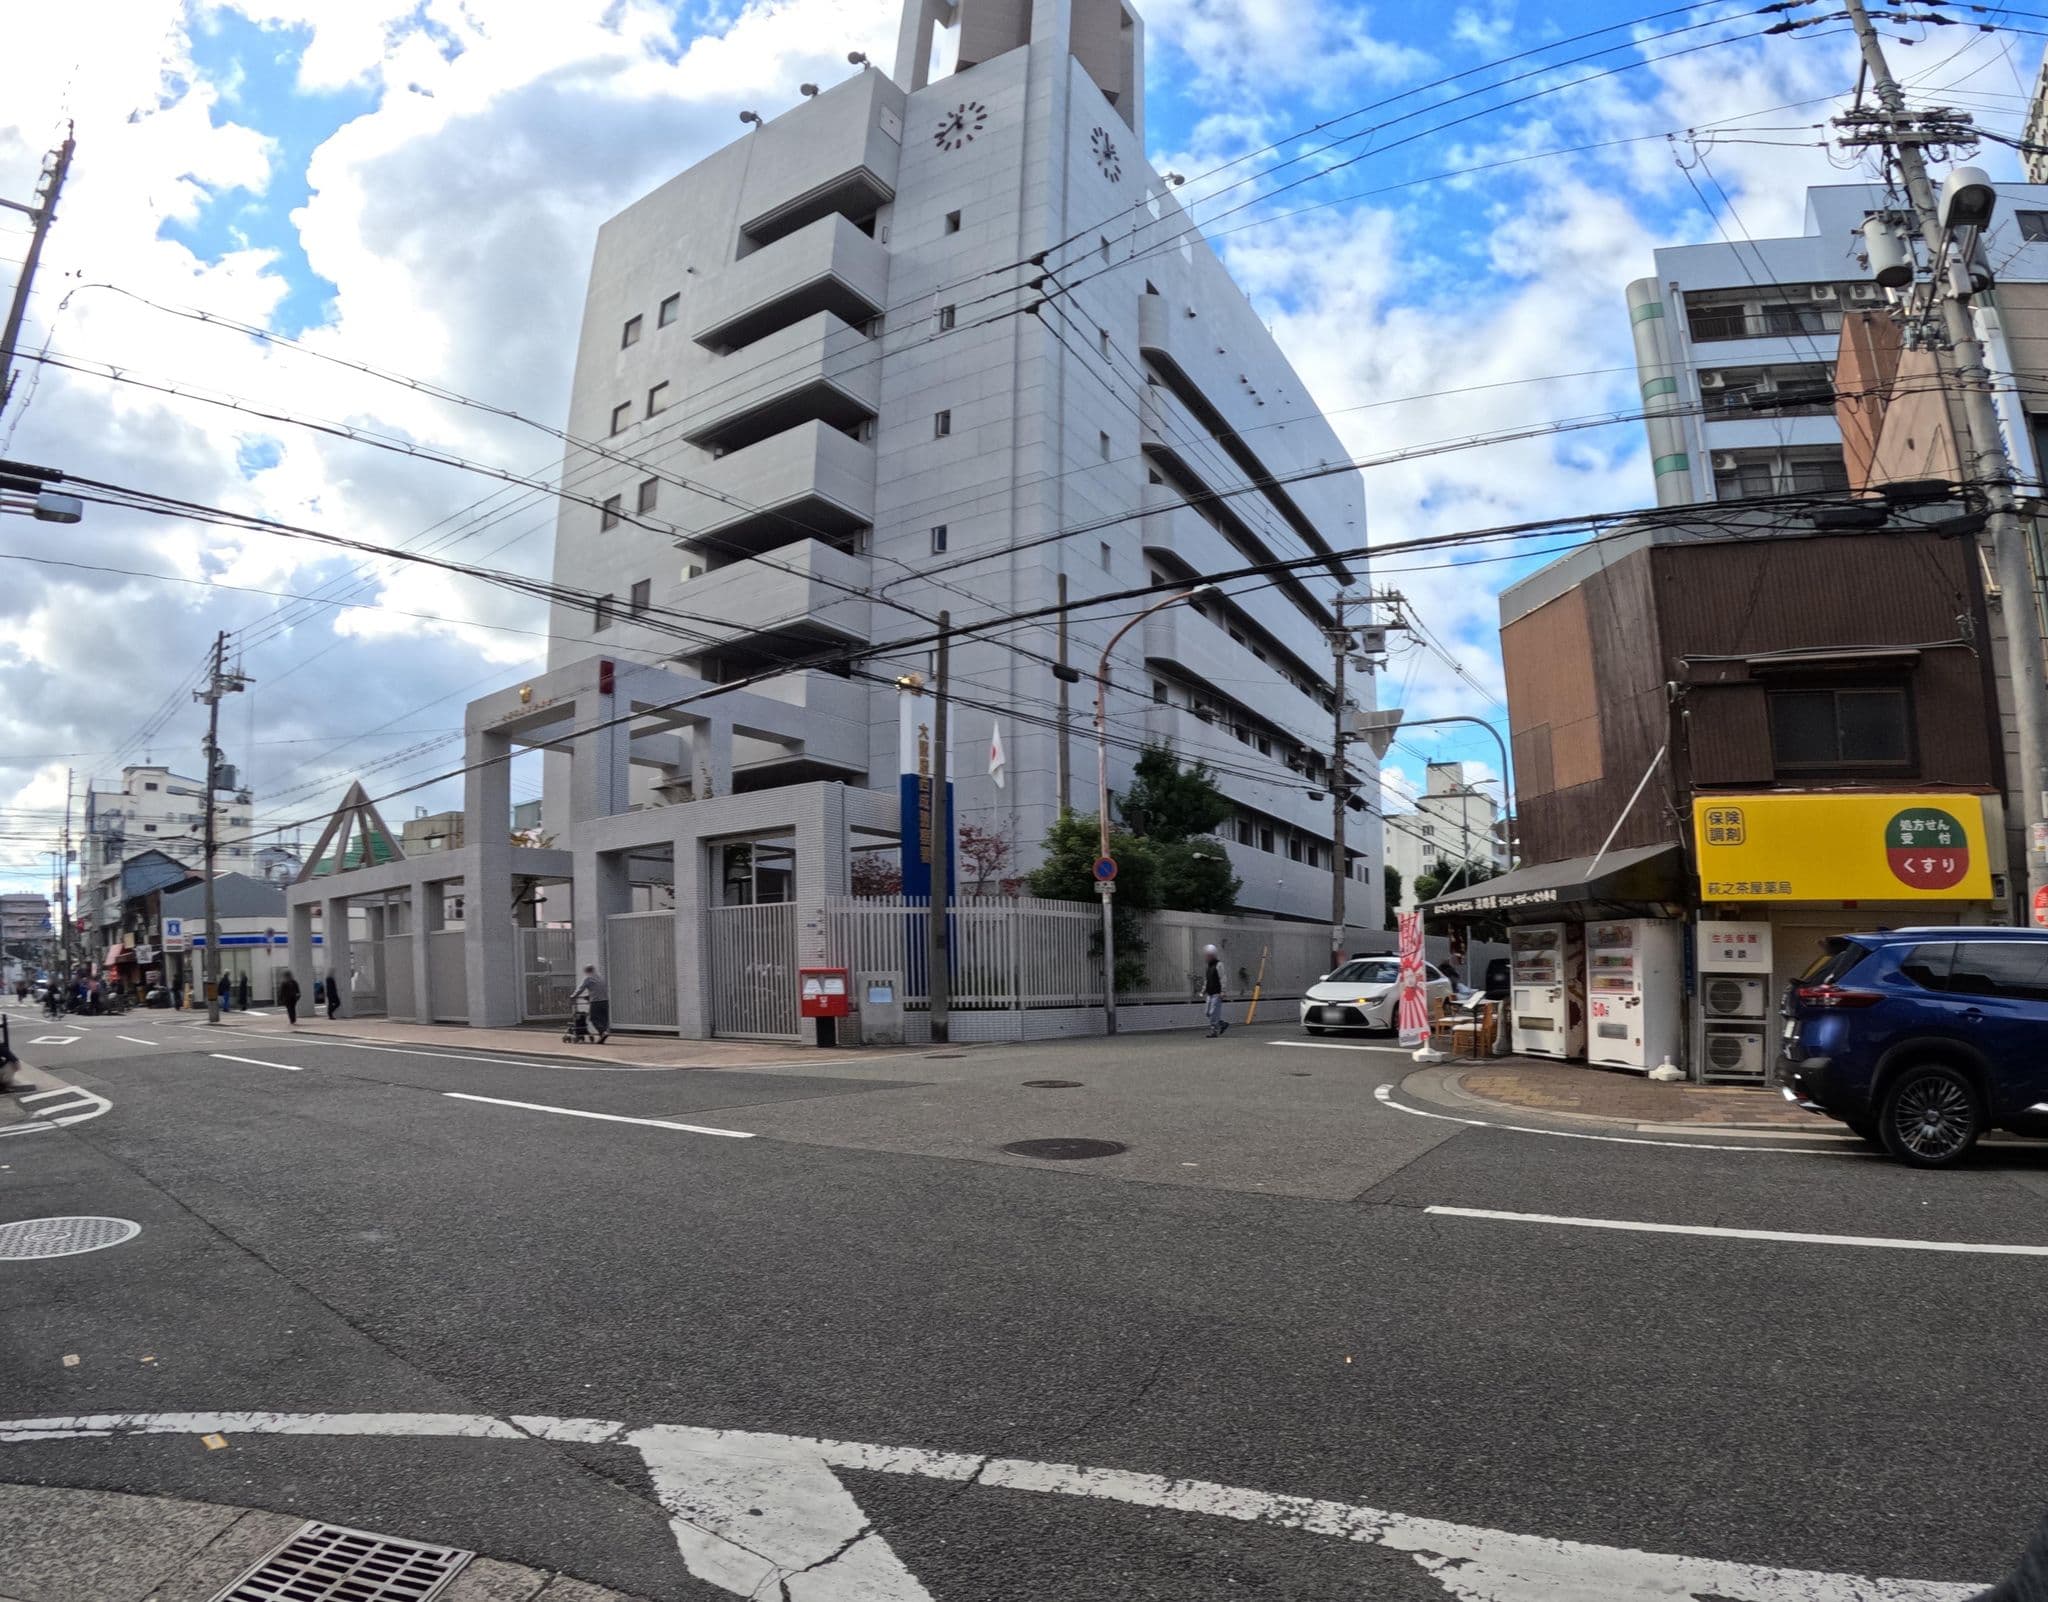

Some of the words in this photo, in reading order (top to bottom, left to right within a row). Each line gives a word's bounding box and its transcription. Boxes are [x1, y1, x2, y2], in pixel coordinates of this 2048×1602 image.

[1709, 811, 1741, 825] 保険
[1900, 819, 1951, 831] 処方せん
[1709, 827, 1742, 842] 調剤
[1903, 858, 1955, 873] くすり
[1707, 881, 1793, 895] 萩之茶屋薬局
